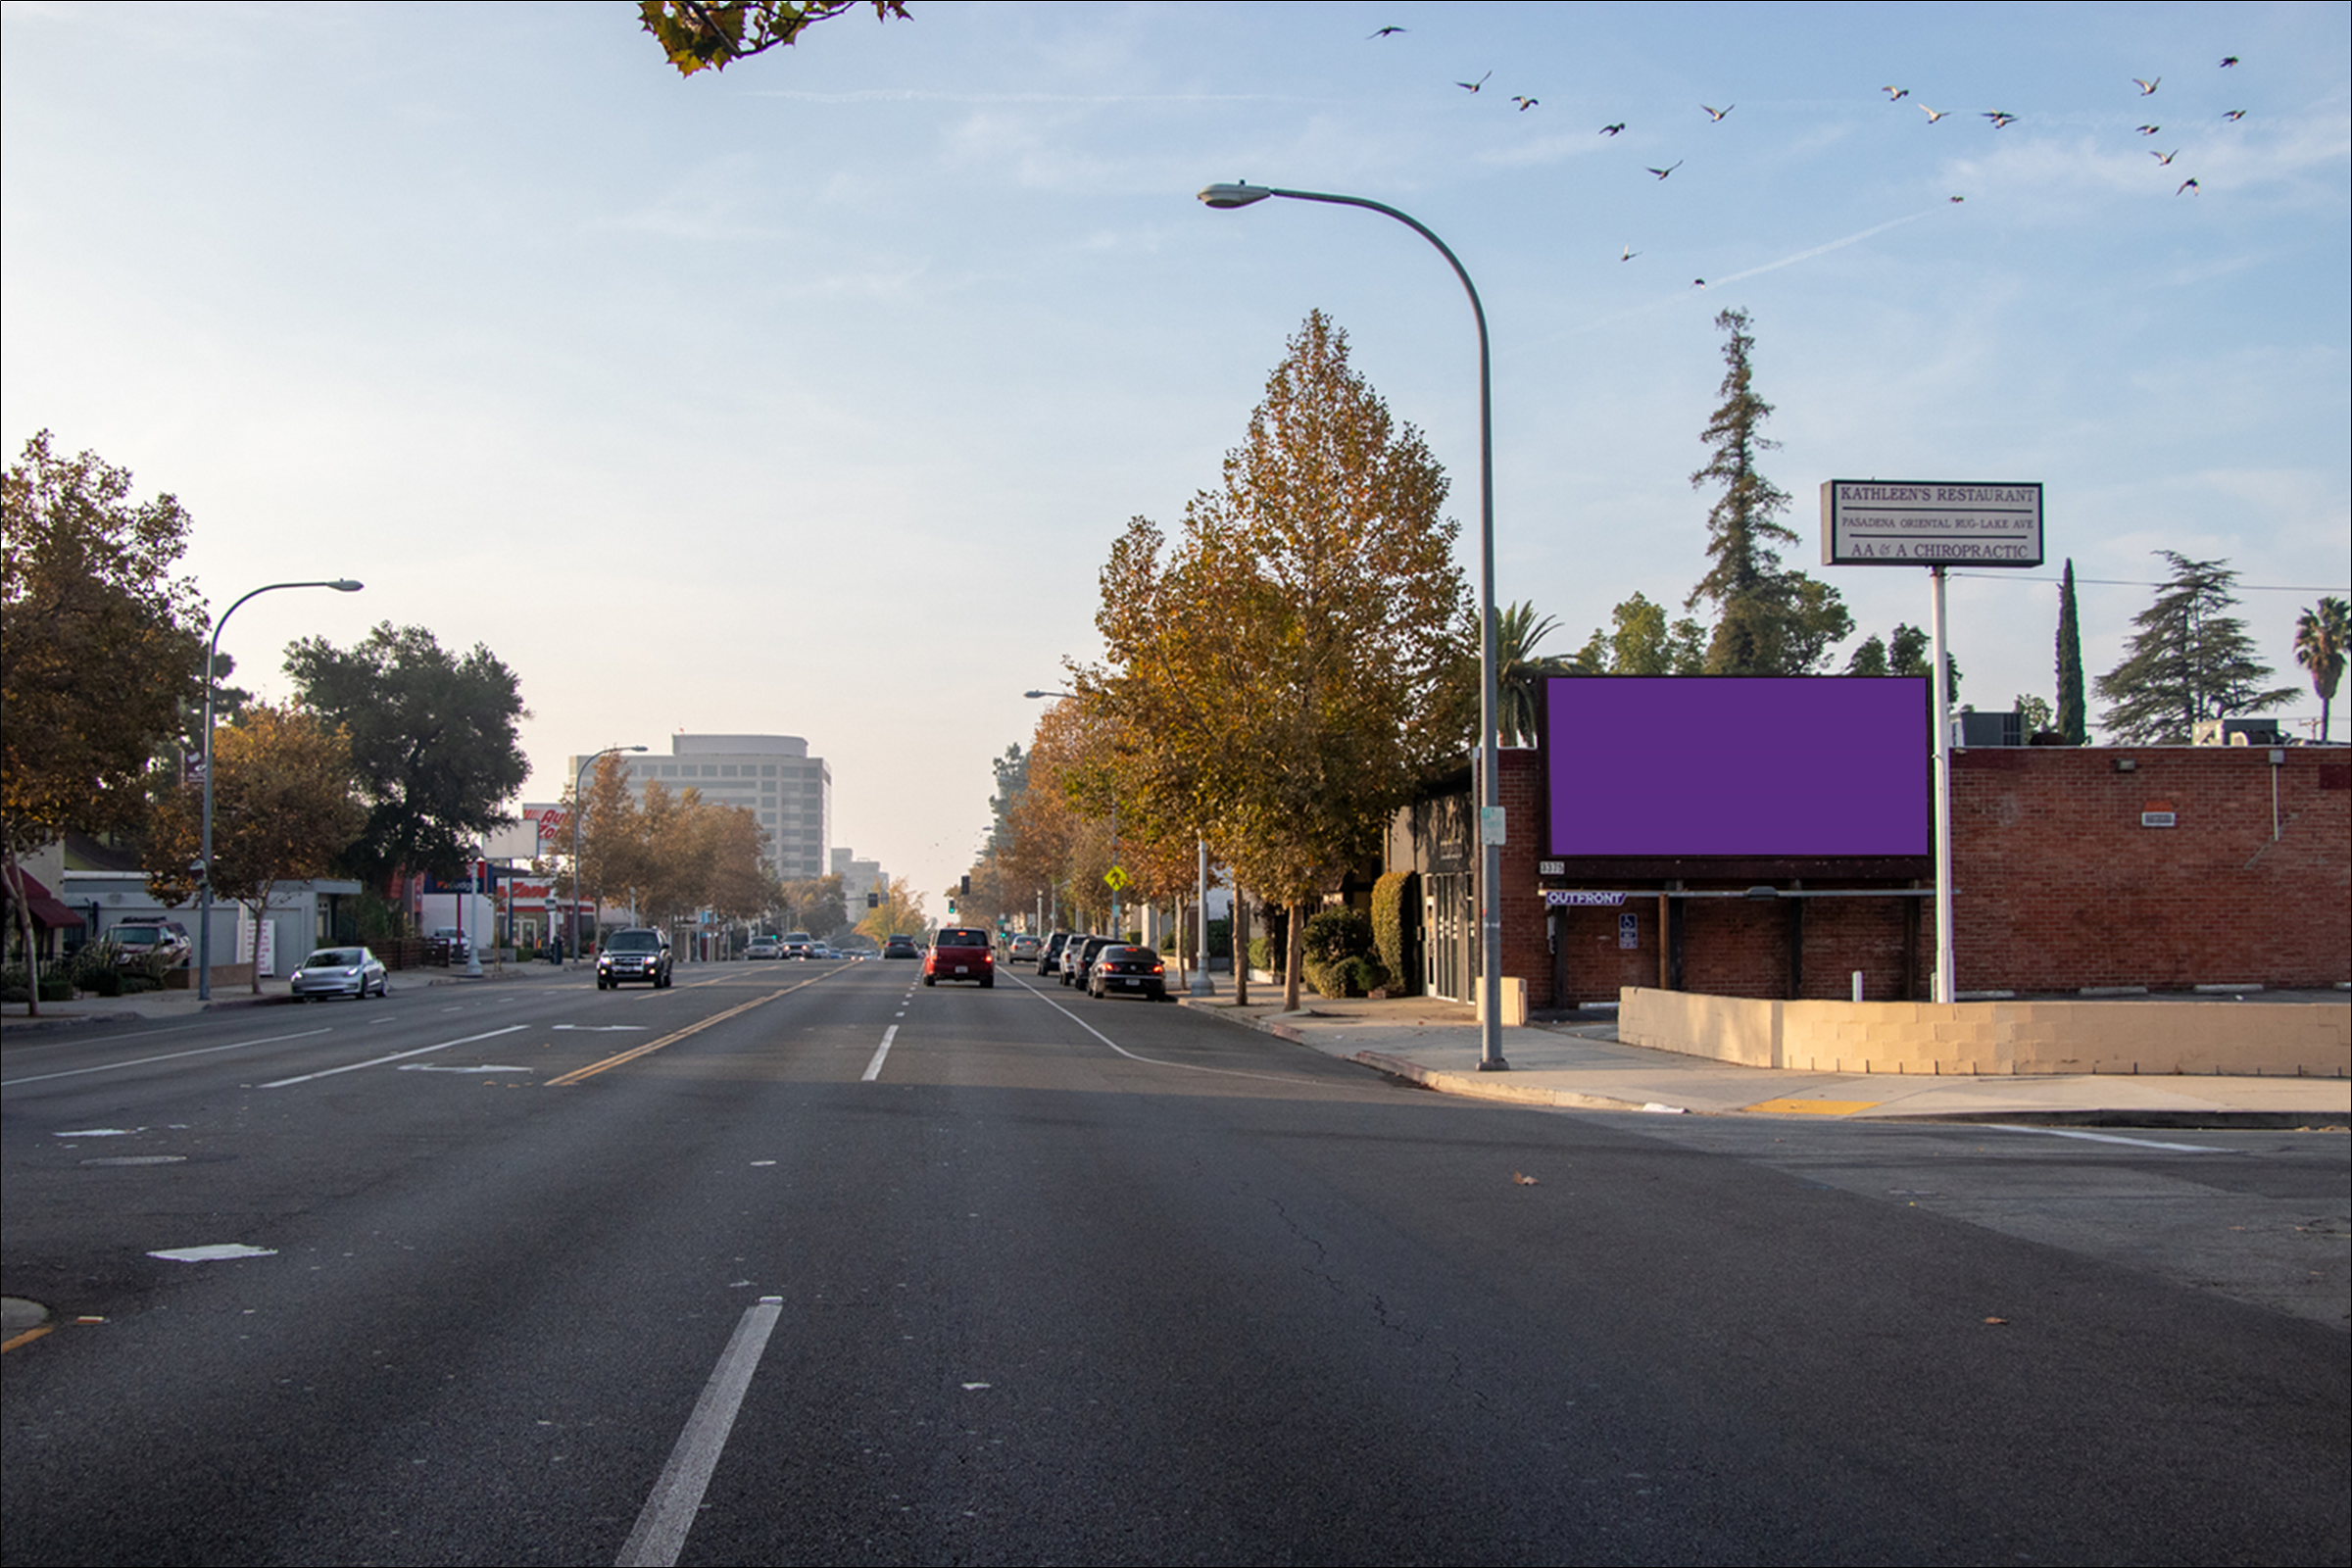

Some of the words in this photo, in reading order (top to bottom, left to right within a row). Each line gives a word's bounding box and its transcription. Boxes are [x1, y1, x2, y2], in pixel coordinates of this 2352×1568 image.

[1840, 487, 1931, 501] KATHLEEN'S
[1936, 488, 2034, 502] RESTAURANT
[1842, 517, 1895, 528] PASADENA
[1899, 518, 1951, 528] ORIENTAL
[2013, 519, 2034, 529] AVE
[1851, 543, 1875, 557] AA
[1879, 544, 1891, 556] &
[1895, 544, 1907, 557] A
[1914, 544, 2028, 559] CHIROPRACTIC
[541, 809, 565, 824] Au
[1548, 892, 1623, 904] OUTFRONT
